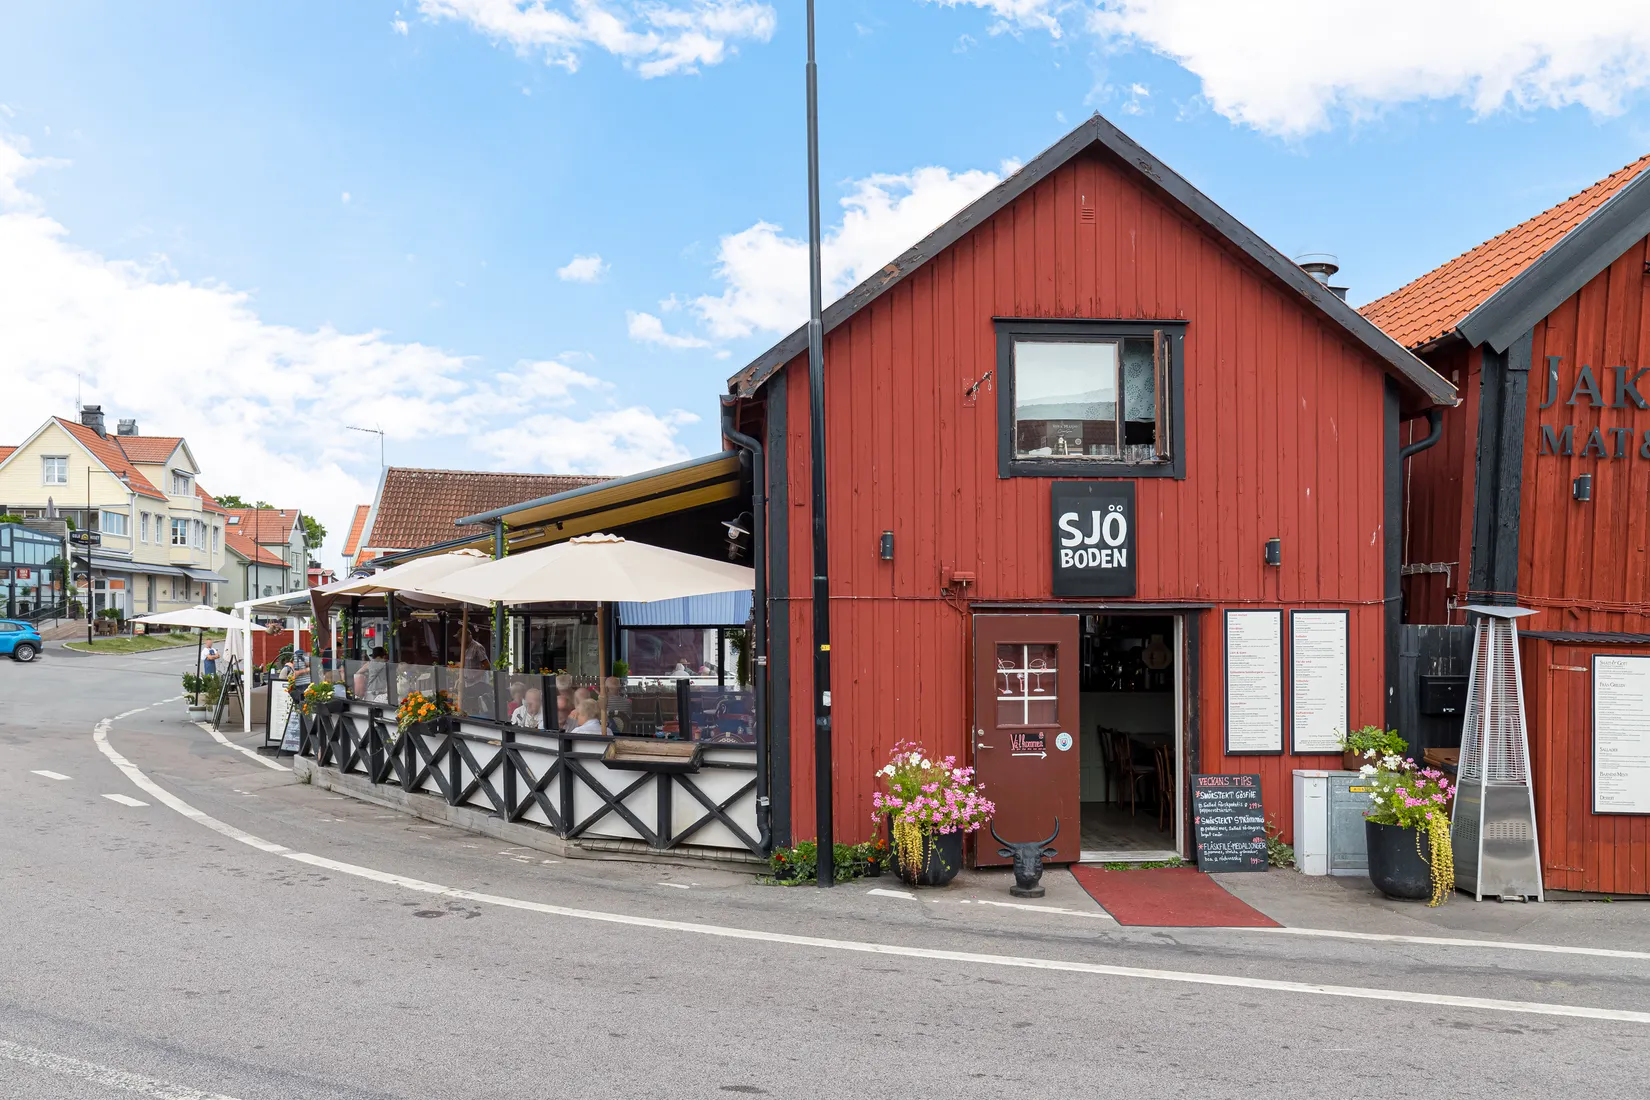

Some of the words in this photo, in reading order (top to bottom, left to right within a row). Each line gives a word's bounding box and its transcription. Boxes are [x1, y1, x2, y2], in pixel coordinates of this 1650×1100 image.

[1058, 504, 1127, 547] SJÖ
[1060, 548, 1127, 568] BODEN
[1198, 777, 1229, 785] VECKANS
